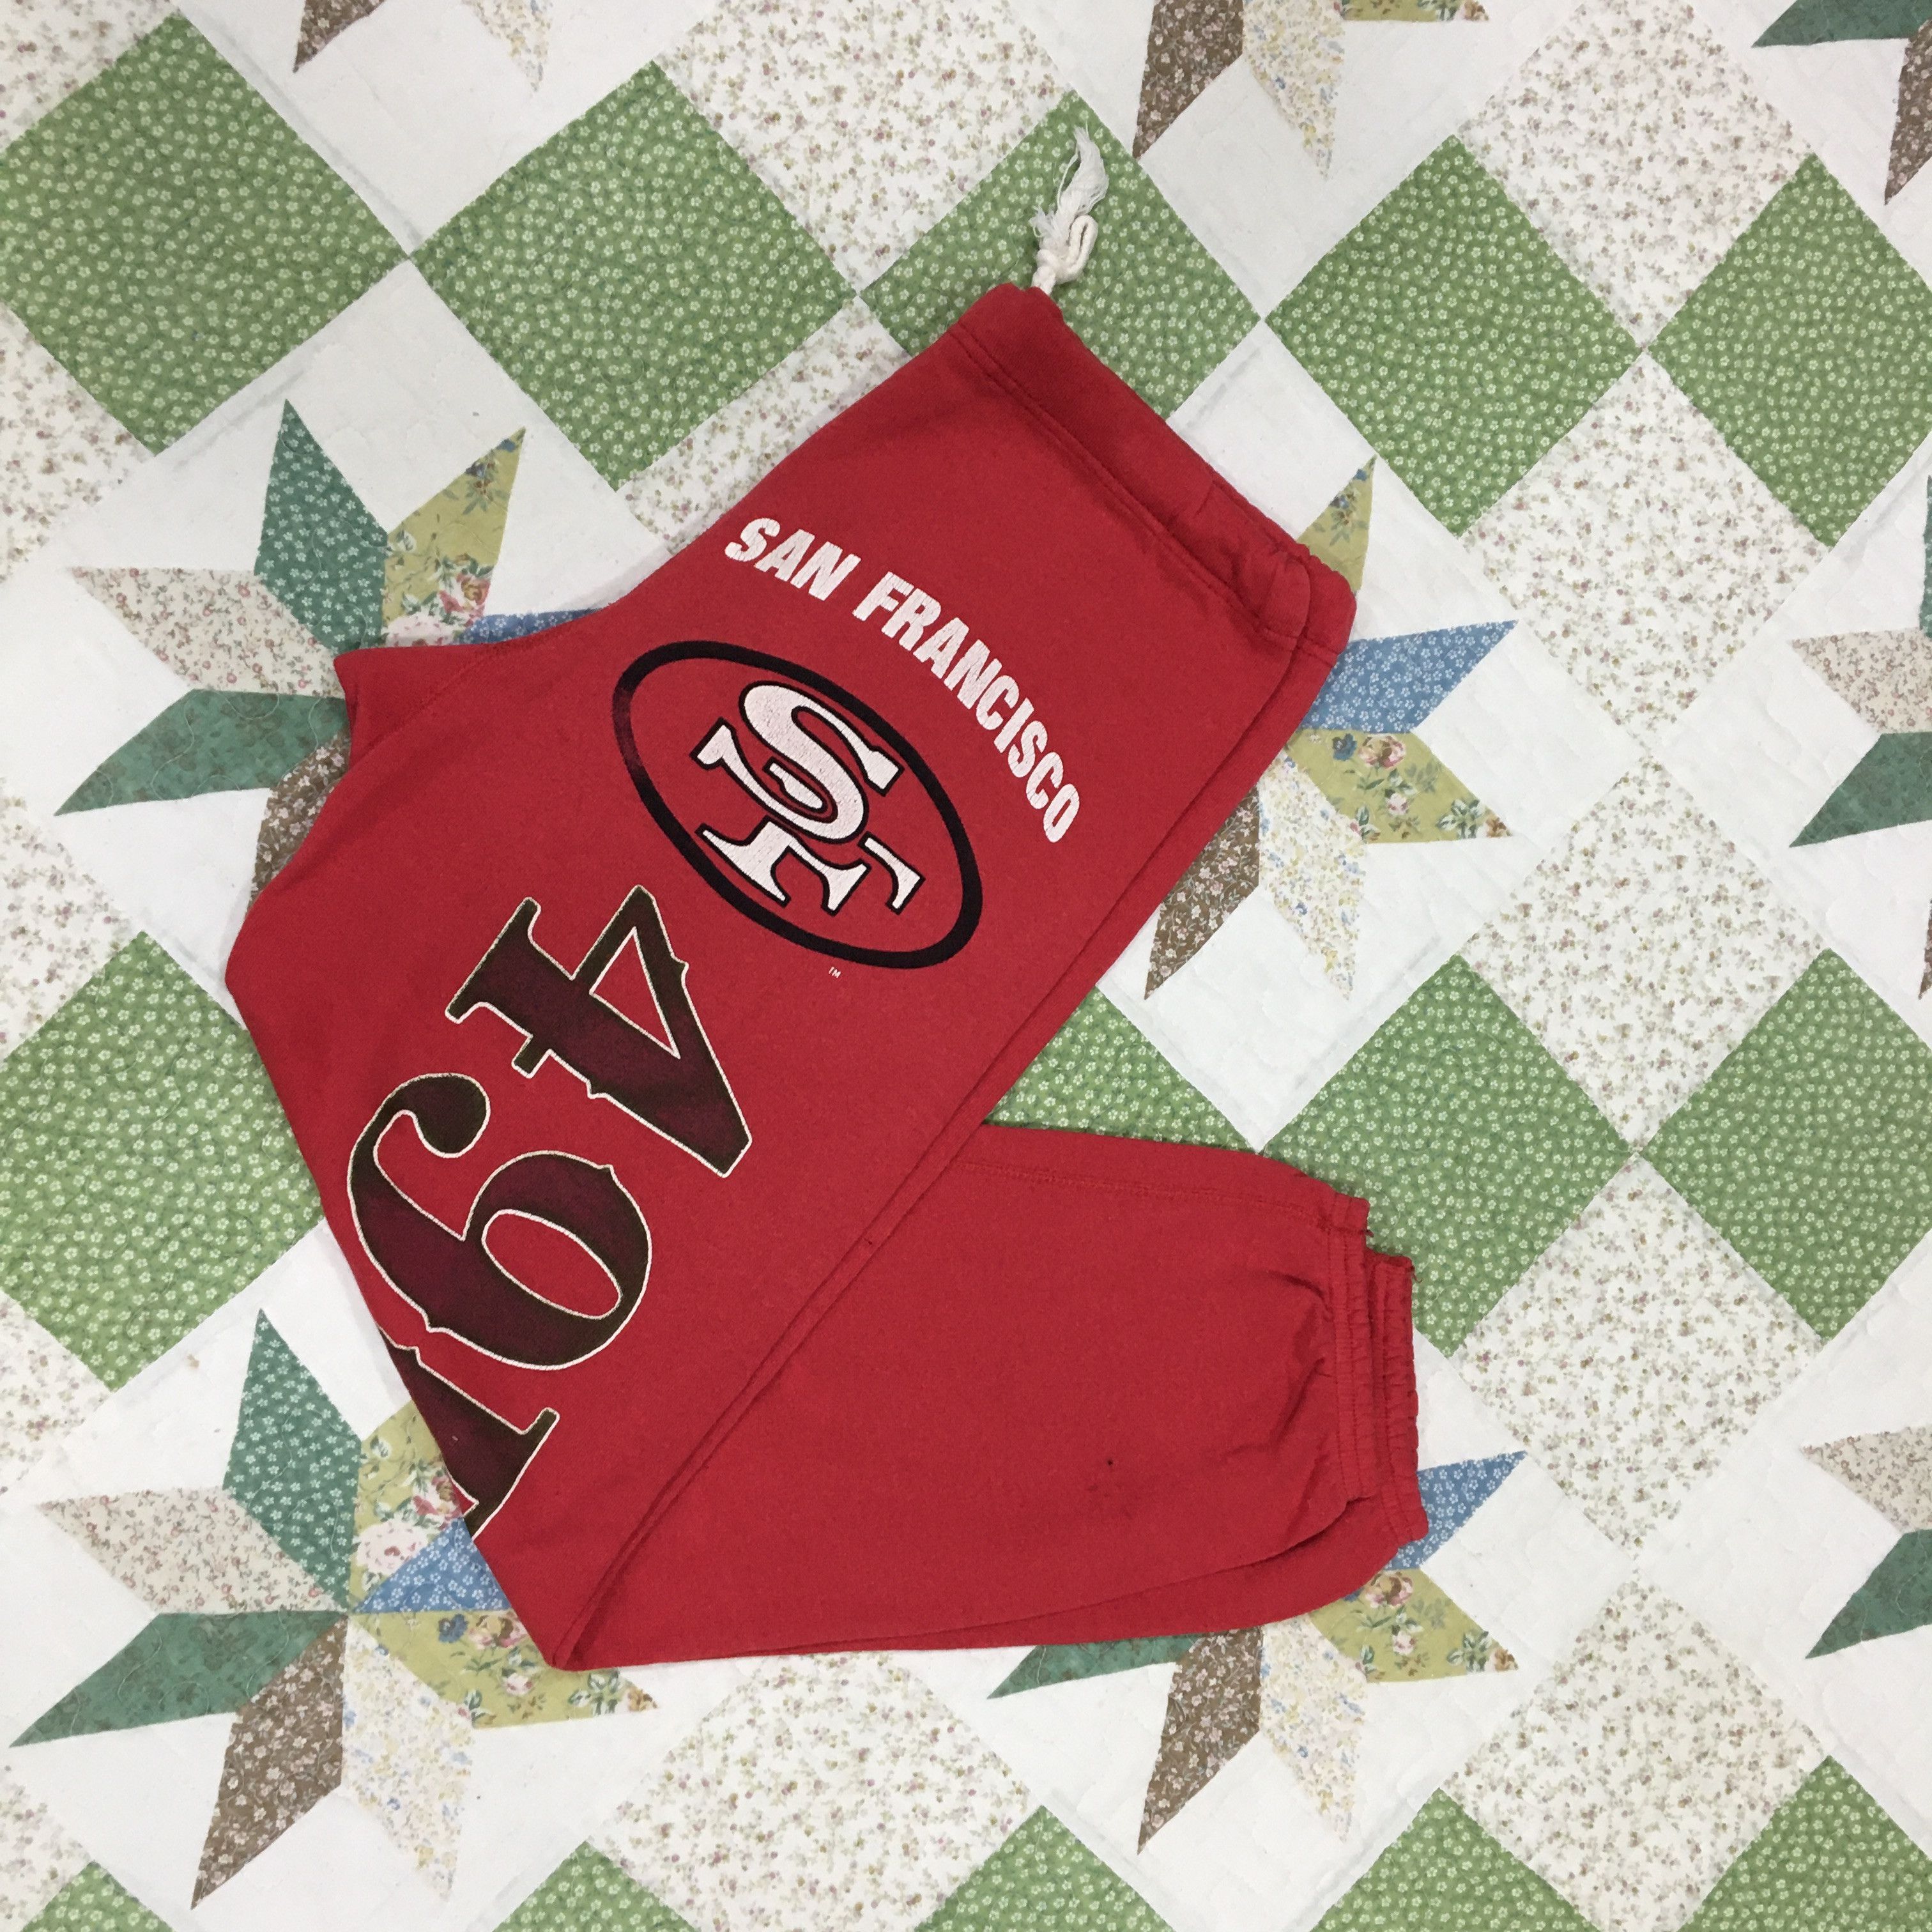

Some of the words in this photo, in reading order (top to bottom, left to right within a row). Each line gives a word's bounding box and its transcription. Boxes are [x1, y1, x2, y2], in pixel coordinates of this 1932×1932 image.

[690, 680, 925, 916] SF
[724, 517, 861, 601] SAN
[852, 572, 1080, 843] FRANCISCO
